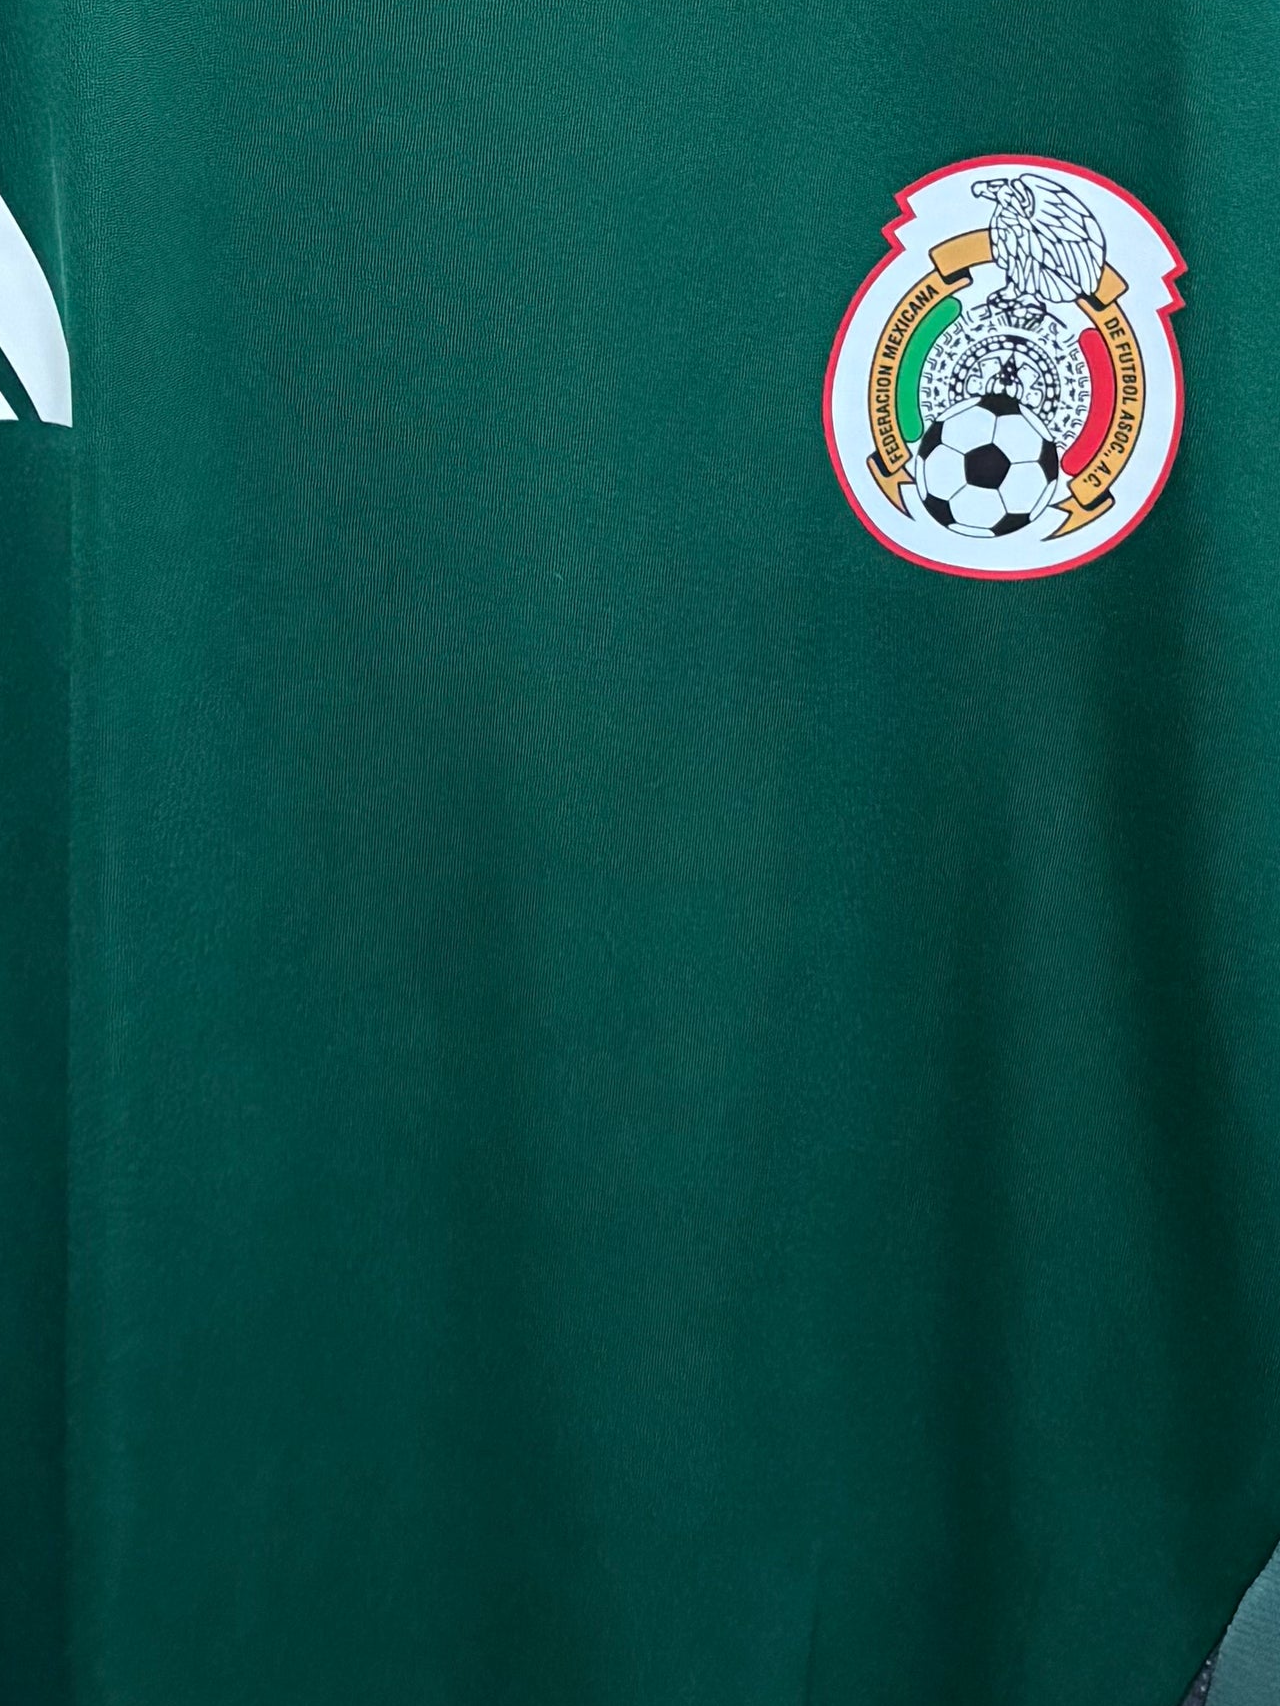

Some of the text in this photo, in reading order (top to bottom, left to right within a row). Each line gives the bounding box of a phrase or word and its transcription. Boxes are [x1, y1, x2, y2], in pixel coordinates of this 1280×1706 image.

[876, 284, 940, 464] FEDERACION MEXICANA
[1103, 316, 1126, 341] DE
[1115, 342, 1138, 405] FUTBOL
